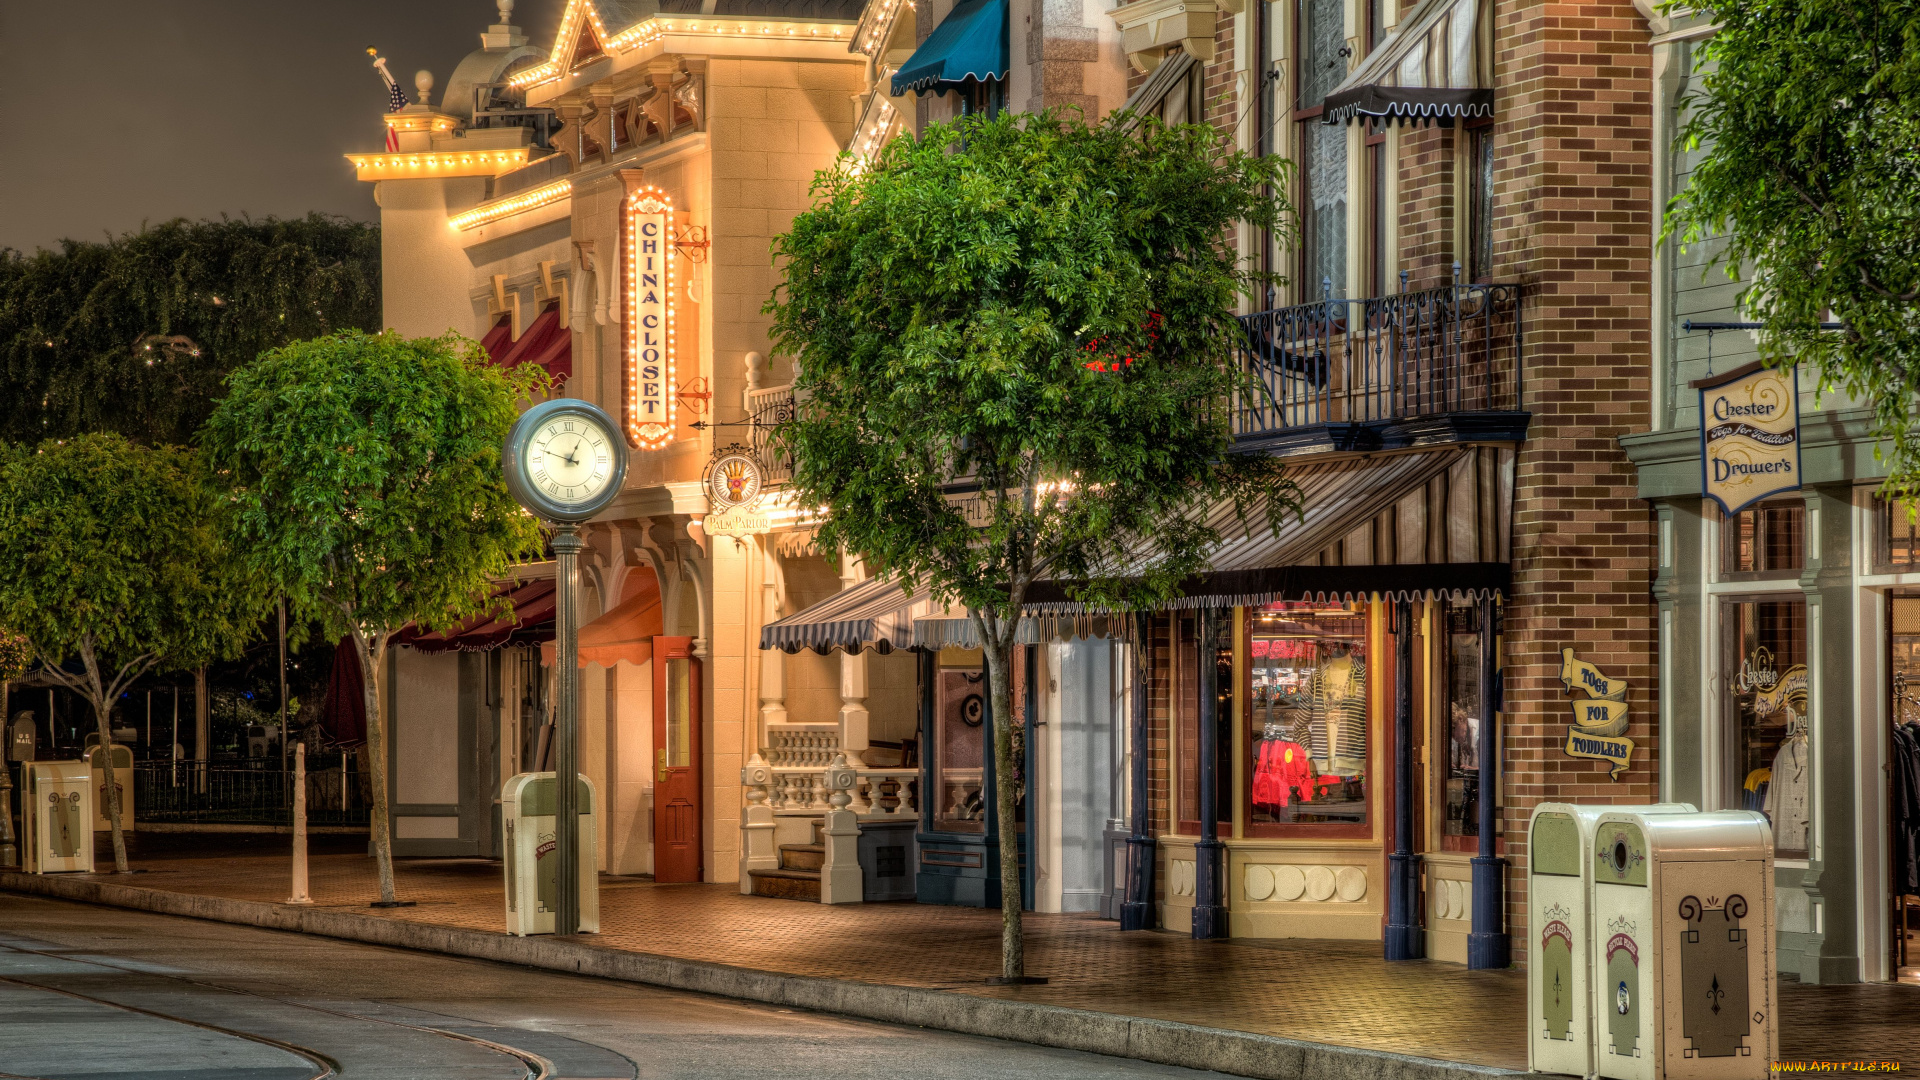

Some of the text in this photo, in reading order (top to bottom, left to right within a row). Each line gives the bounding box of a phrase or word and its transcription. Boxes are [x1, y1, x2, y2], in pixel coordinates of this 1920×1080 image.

[641, 222, 660, 414] CHINA CLOSET
[1713, 396, 1775, 421] Chester
[563, 421, 574, 432] XII
[1711, 423, 1793, 444] Togs for Toddlers
[1712, 457, 1791, 482] Drawer's
[709, 516, 768, 530] PALM PARLOR
[1581, 667, 1608, 695] TOGS
[1740, 658, 1777, 692] Chester
[1586, 706, 1609, 721] FOR
[1572, 737, 1628, 759] TODDLERS
